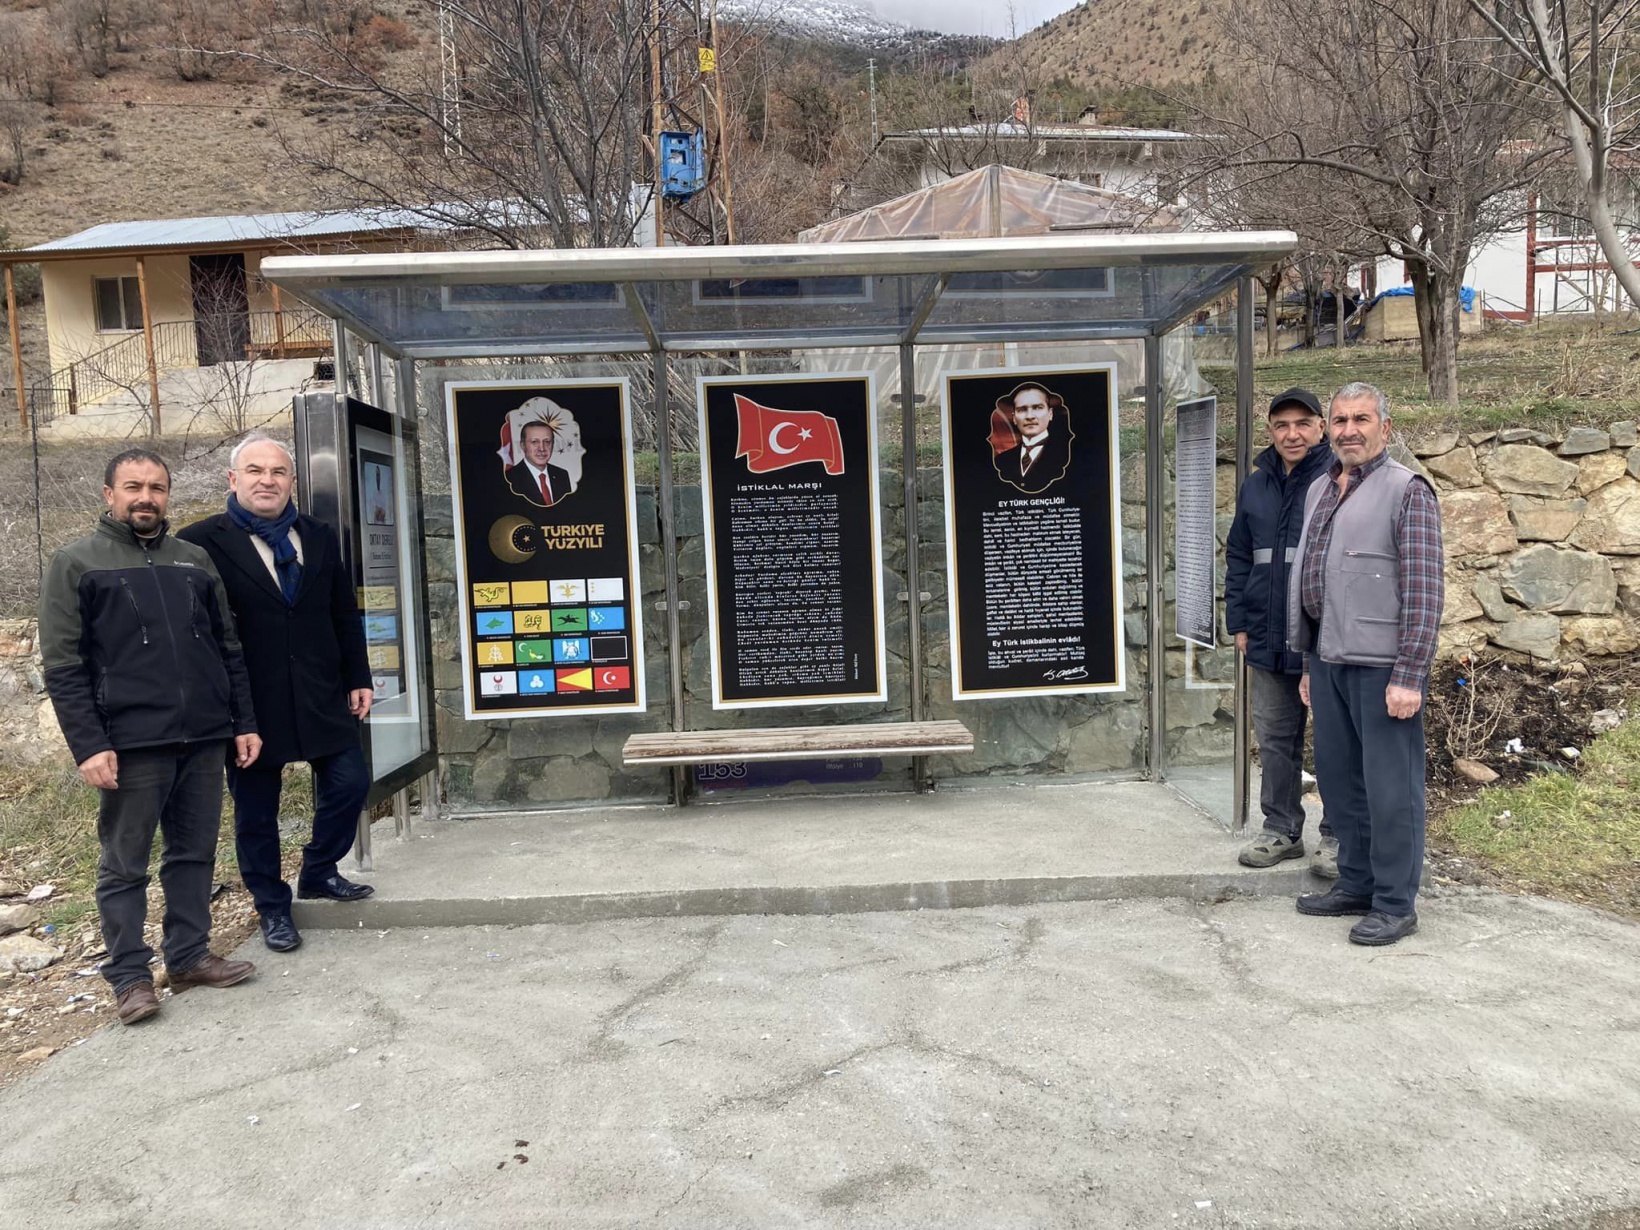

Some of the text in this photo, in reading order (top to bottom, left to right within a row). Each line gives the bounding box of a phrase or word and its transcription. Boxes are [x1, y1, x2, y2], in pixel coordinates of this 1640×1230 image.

[737, 482, 822, 491] İSTİKLAL MARŞI
[998, 500, 1008, 508] EY
[1009, 499, 1029, 507] TÜRK
[992, 640, 1001, 648] Ey
[698, 761, 748, 780] 153
